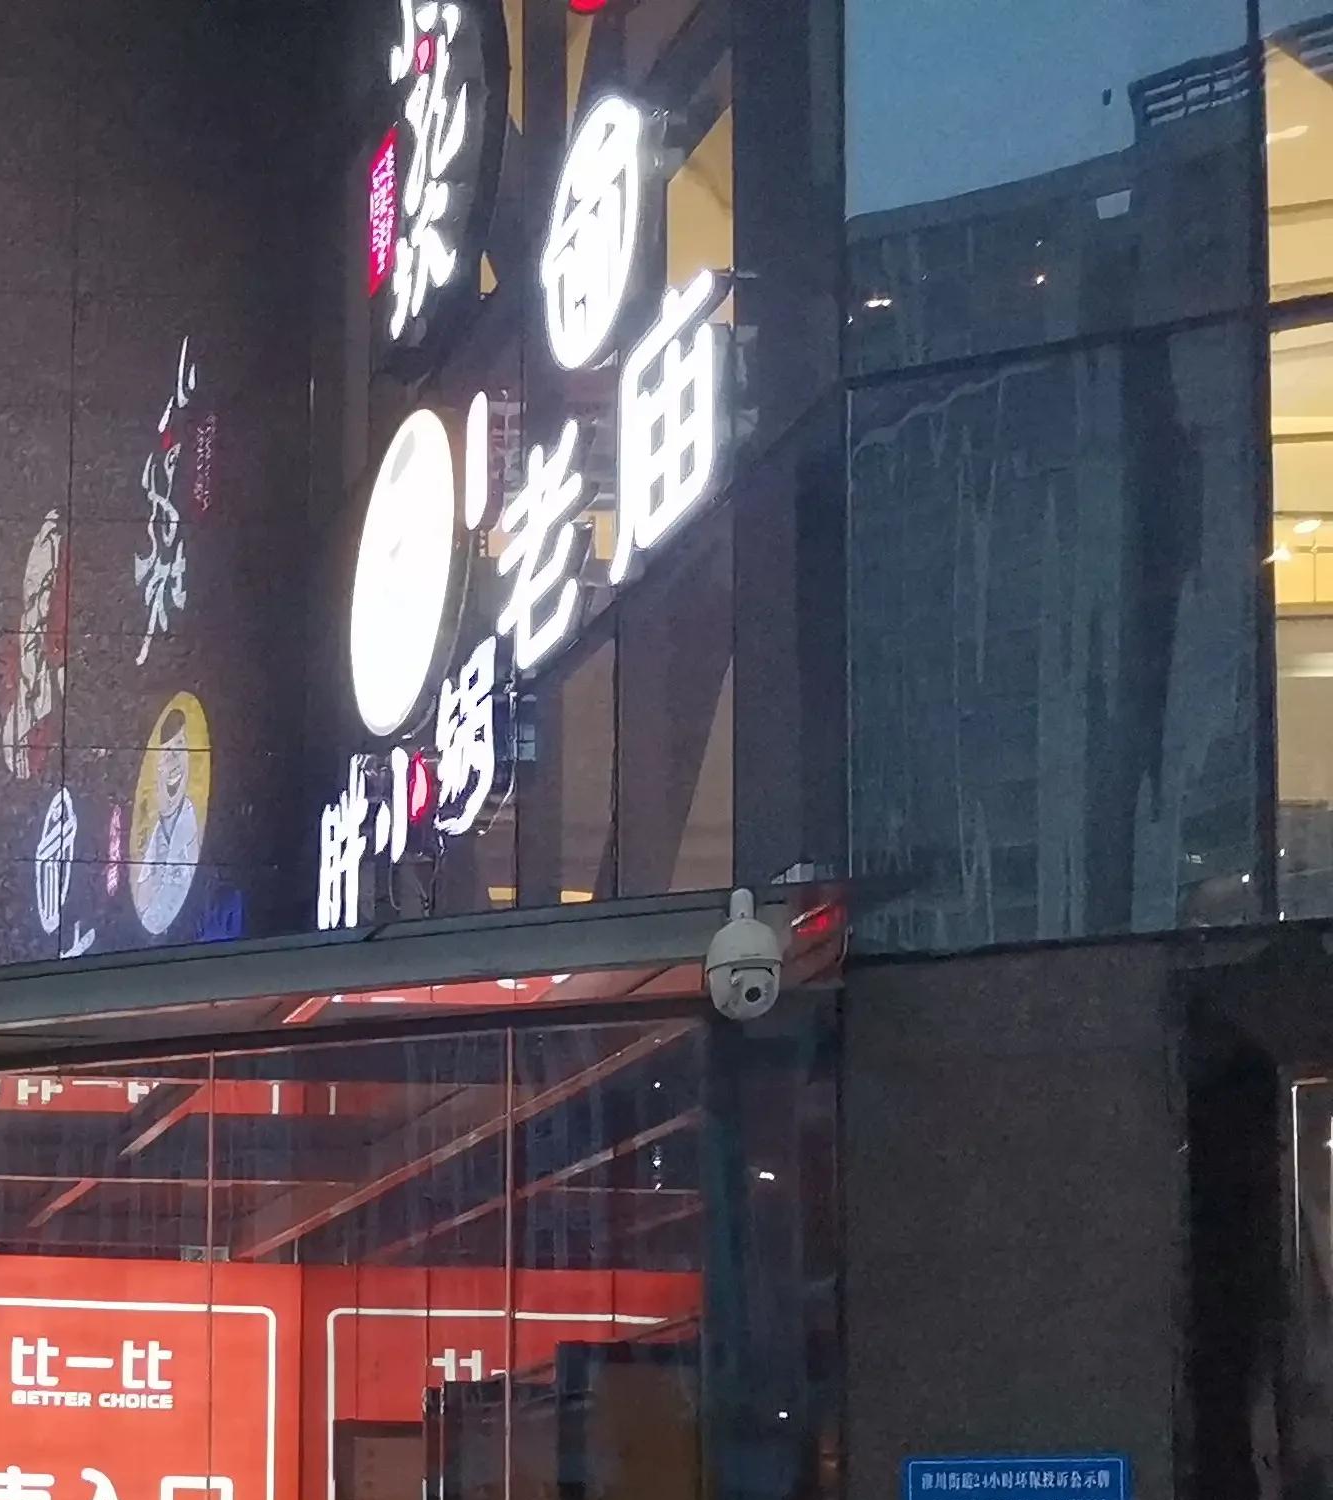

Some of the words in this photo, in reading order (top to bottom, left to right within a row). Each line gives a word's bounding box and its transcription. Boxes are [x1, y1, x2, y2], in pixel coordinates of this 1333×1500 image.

[10, 1336, 174, 1390] 比一比
[11, 1390, 92, 1407] BETTER
[98, 1392, 174, 1410] CHOICE
